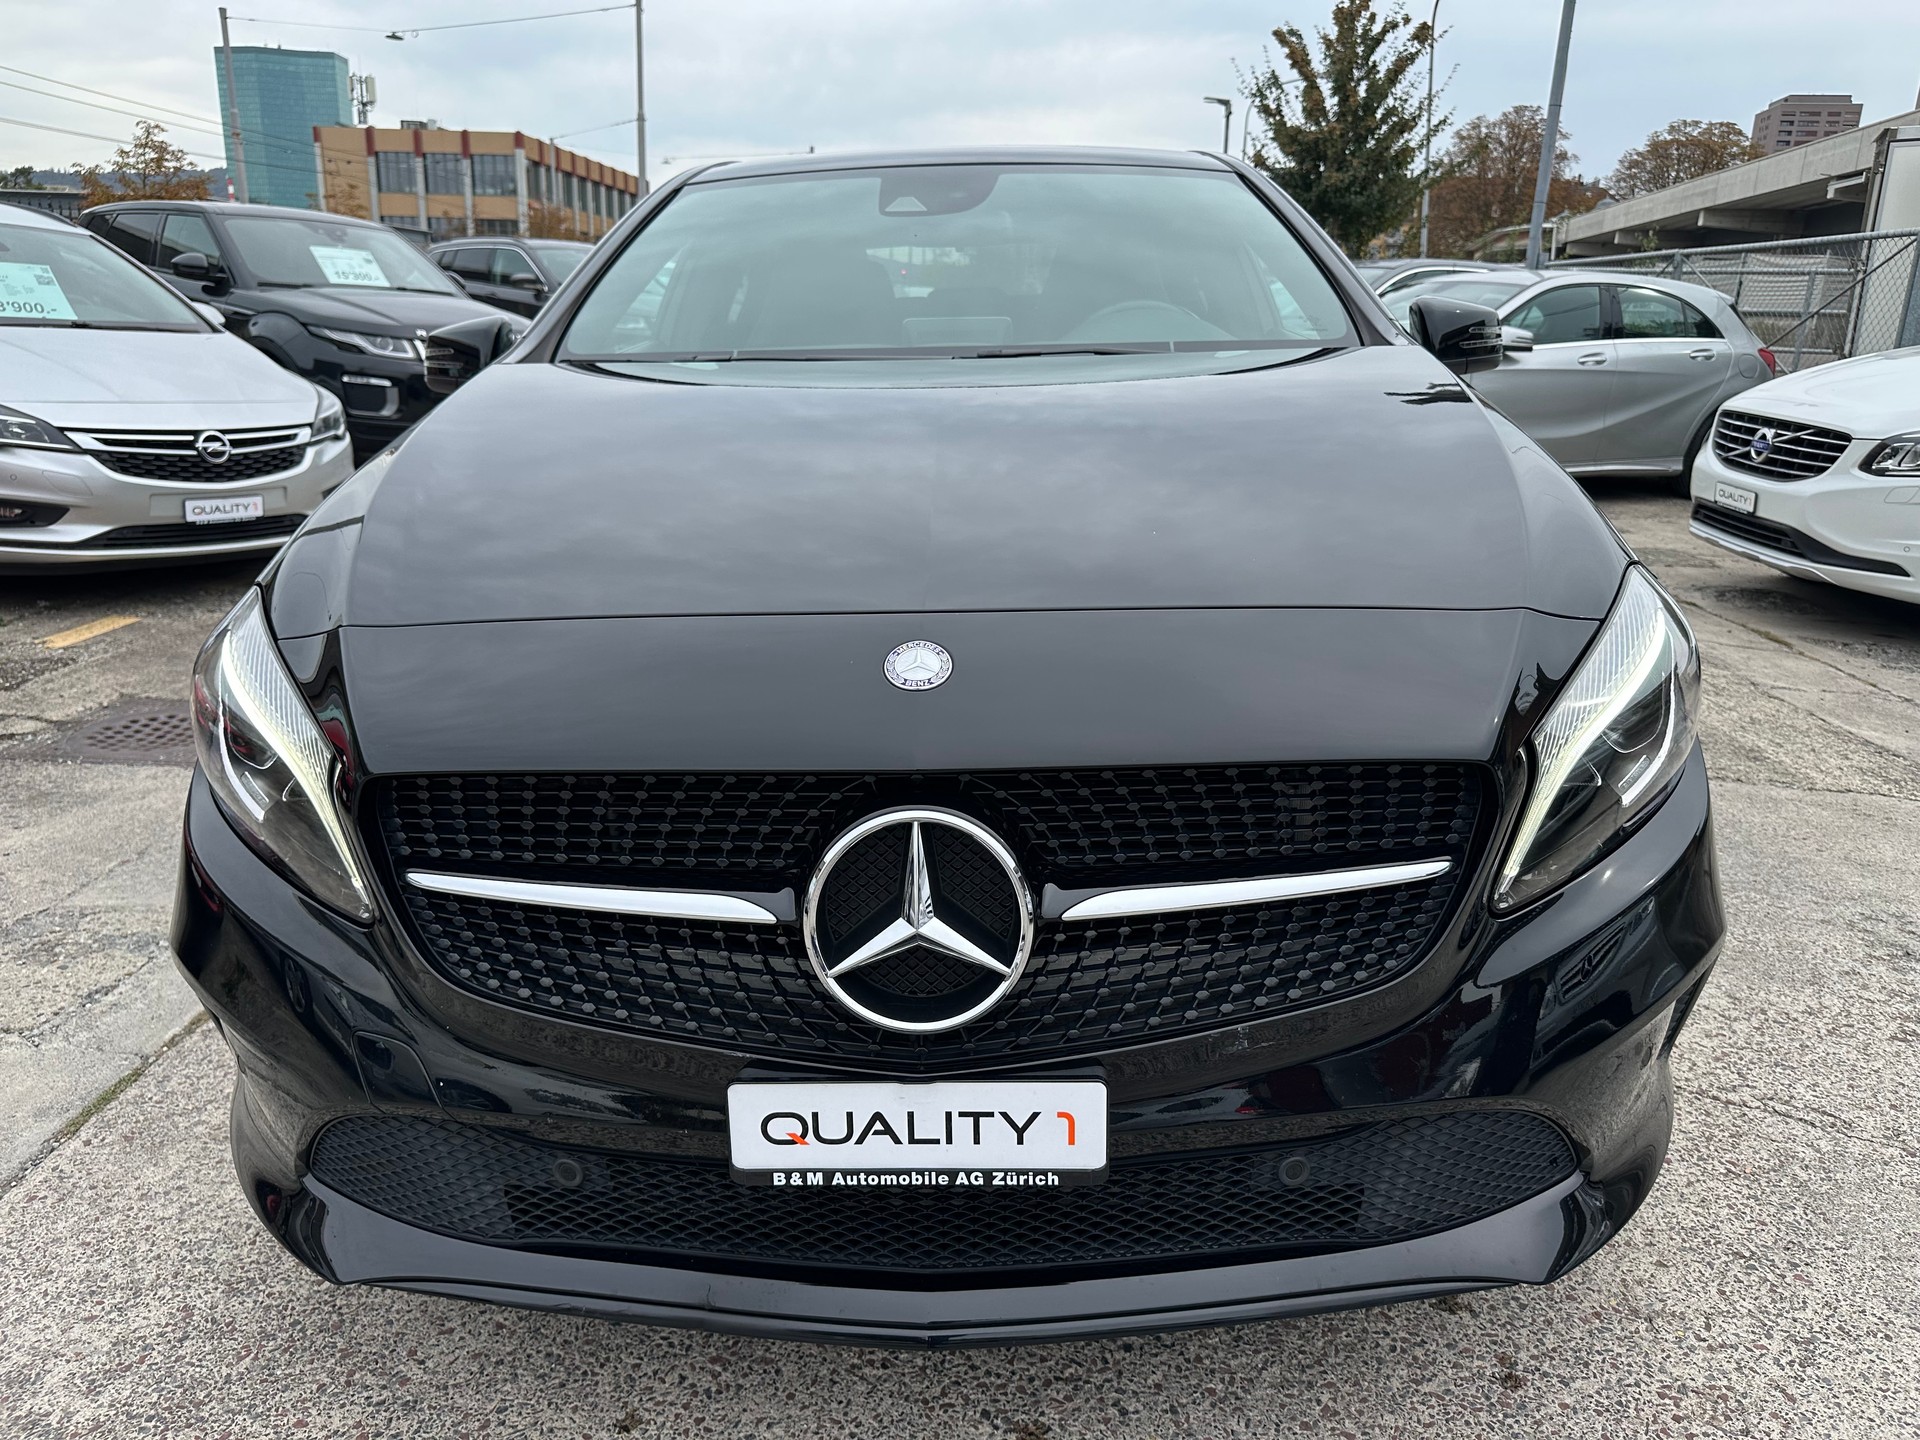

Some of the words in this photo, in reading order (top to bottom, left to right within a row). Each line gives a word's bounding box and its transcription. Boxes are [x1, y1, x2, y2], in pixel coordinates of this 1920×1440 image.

[1718, 489, 1748, 503] QUALITY
[192, 503, 250, 516] QUALITY
[760, 1111, 1042, 1146] QUALITY
[1056, 1111, 1076, 1146] 1
[832, 1171, 949, 1186] Automobile
[955, 1171, 984, 1186] AG
[992, 1171, 1059, 1186] Zürich
